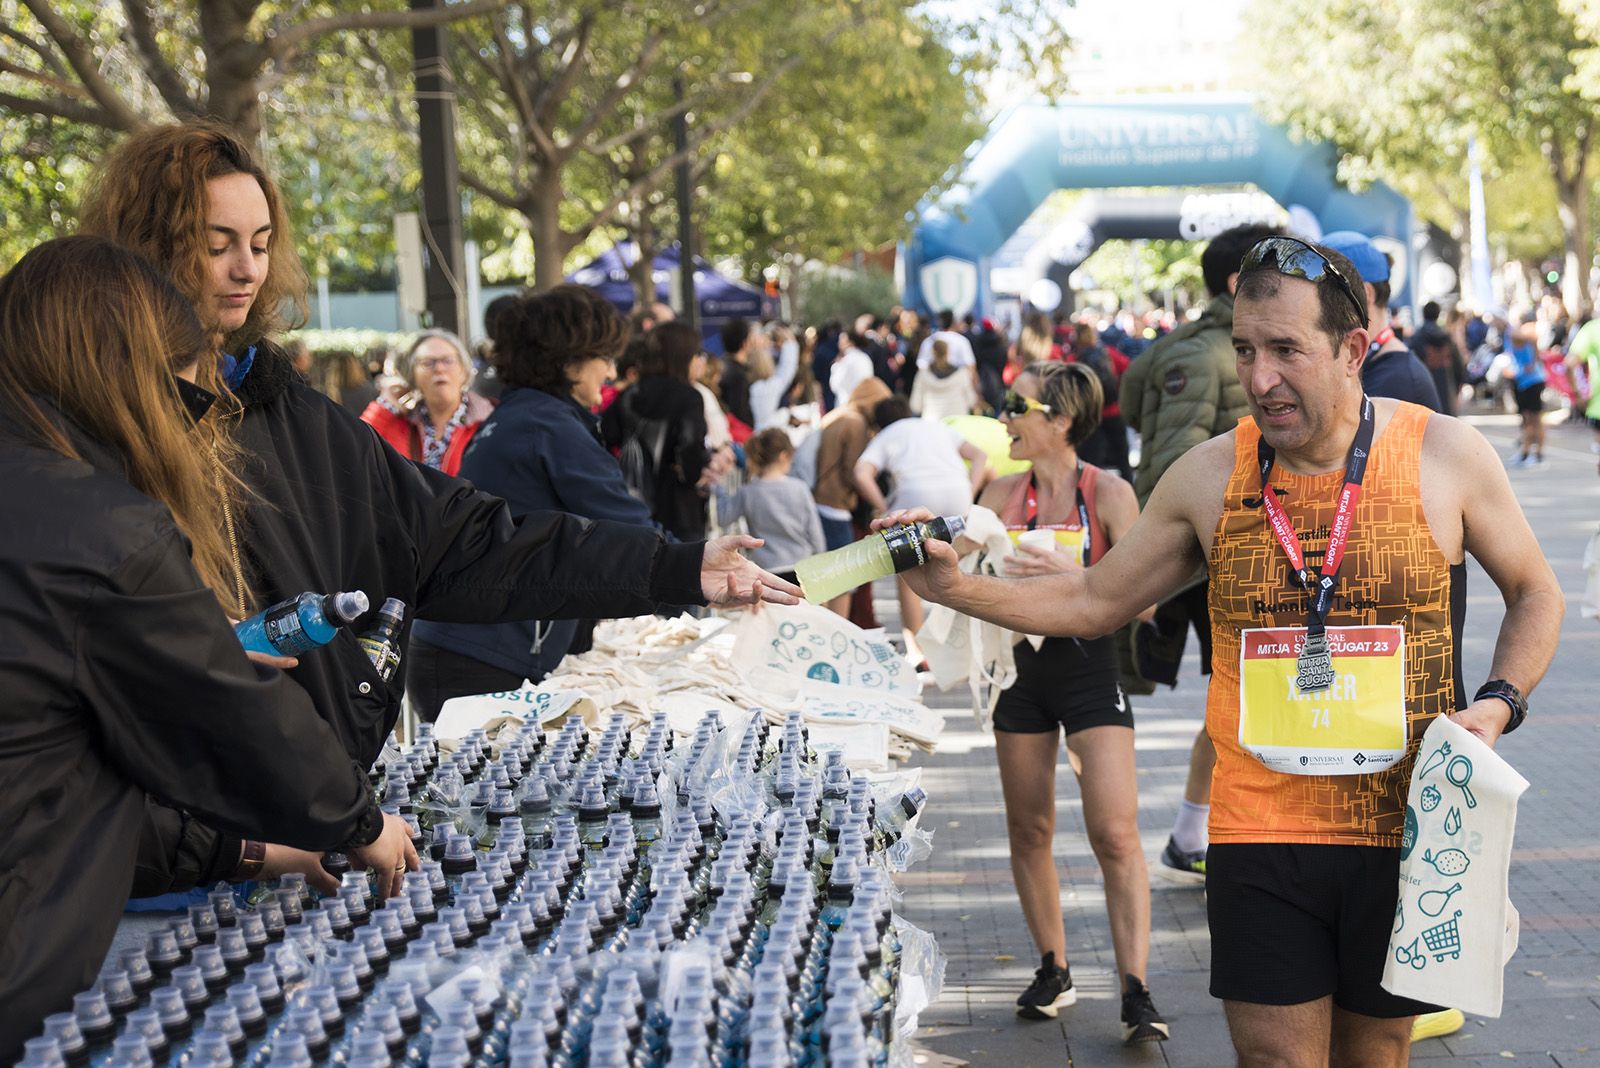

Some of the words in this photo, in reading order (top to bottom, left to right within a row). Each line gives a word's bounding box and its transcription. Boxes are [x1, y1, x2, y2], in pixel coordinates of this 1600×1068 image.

[1339, 490, 1351, 513] MITJA
[1294, 525, 1331, 540] astill
[1333, 515, 1345, 538] SANT
[1272, 516, 1286, 536] SANT
[1281, 536, 1299, 562] CUGAT
[1326, 537, 1339, 567] CUGAT
[1334, 596, 1378, 610] Team
[1294, 633, 1346, 643] UNSAE
[1257, 643, 1290, 655] MITJA
[1329, 642, 1371, 653] CUGAT
[1373, 642, 1389, 652] 23
[1298, 656, 1329, 669] MITJA
[1300, 665, 1329, 677] SANT
[1297, 672, 1334, 686] CUGAT
[1311, 708, 1330, 729] 74
